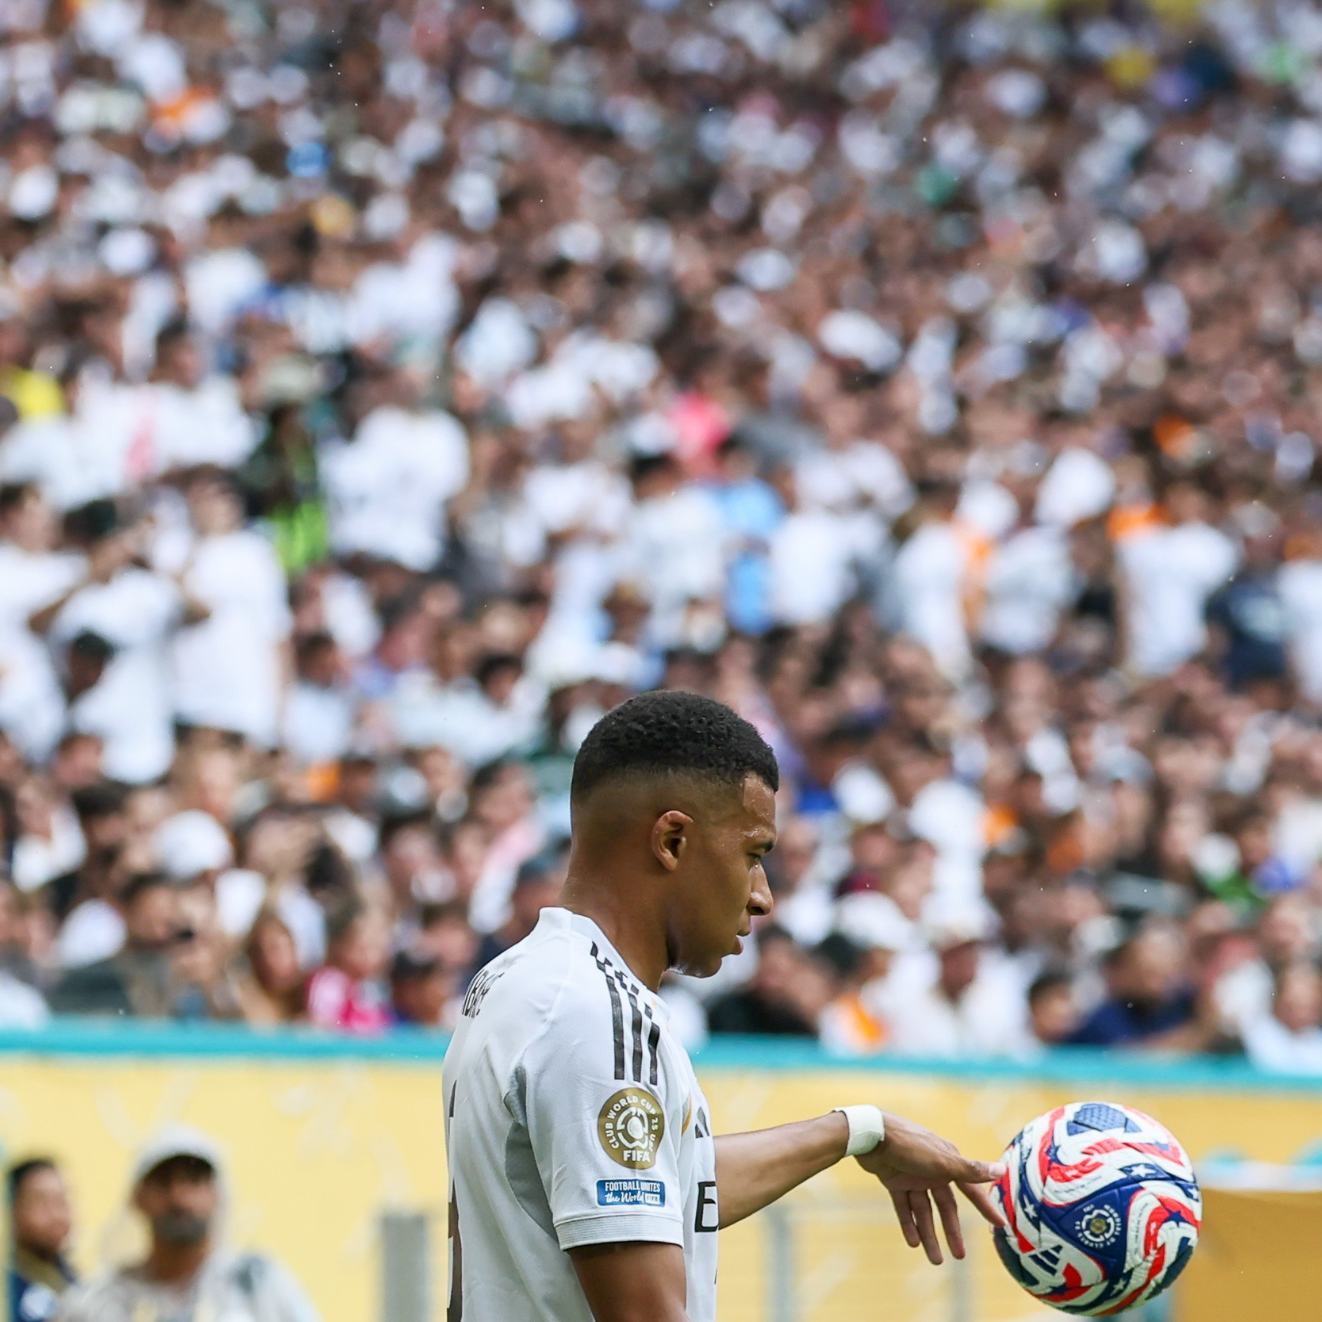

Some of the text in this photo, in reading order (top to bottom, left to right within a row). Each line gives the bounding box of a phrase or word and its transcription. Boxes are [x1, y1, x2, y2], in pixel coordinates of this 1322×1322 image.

[607, 1095, 639, 1119] WORLD
[640, 1098, 657, 1115] CUP
[605, 1122, 620, 1149] CLUB
[623, 1150, 651, 1162] FIFA
[605, 1181, 639, 1192] FOOTBALL
[605, 1191, 620, 1203] the
[620, 1191, 645, 1204] World
